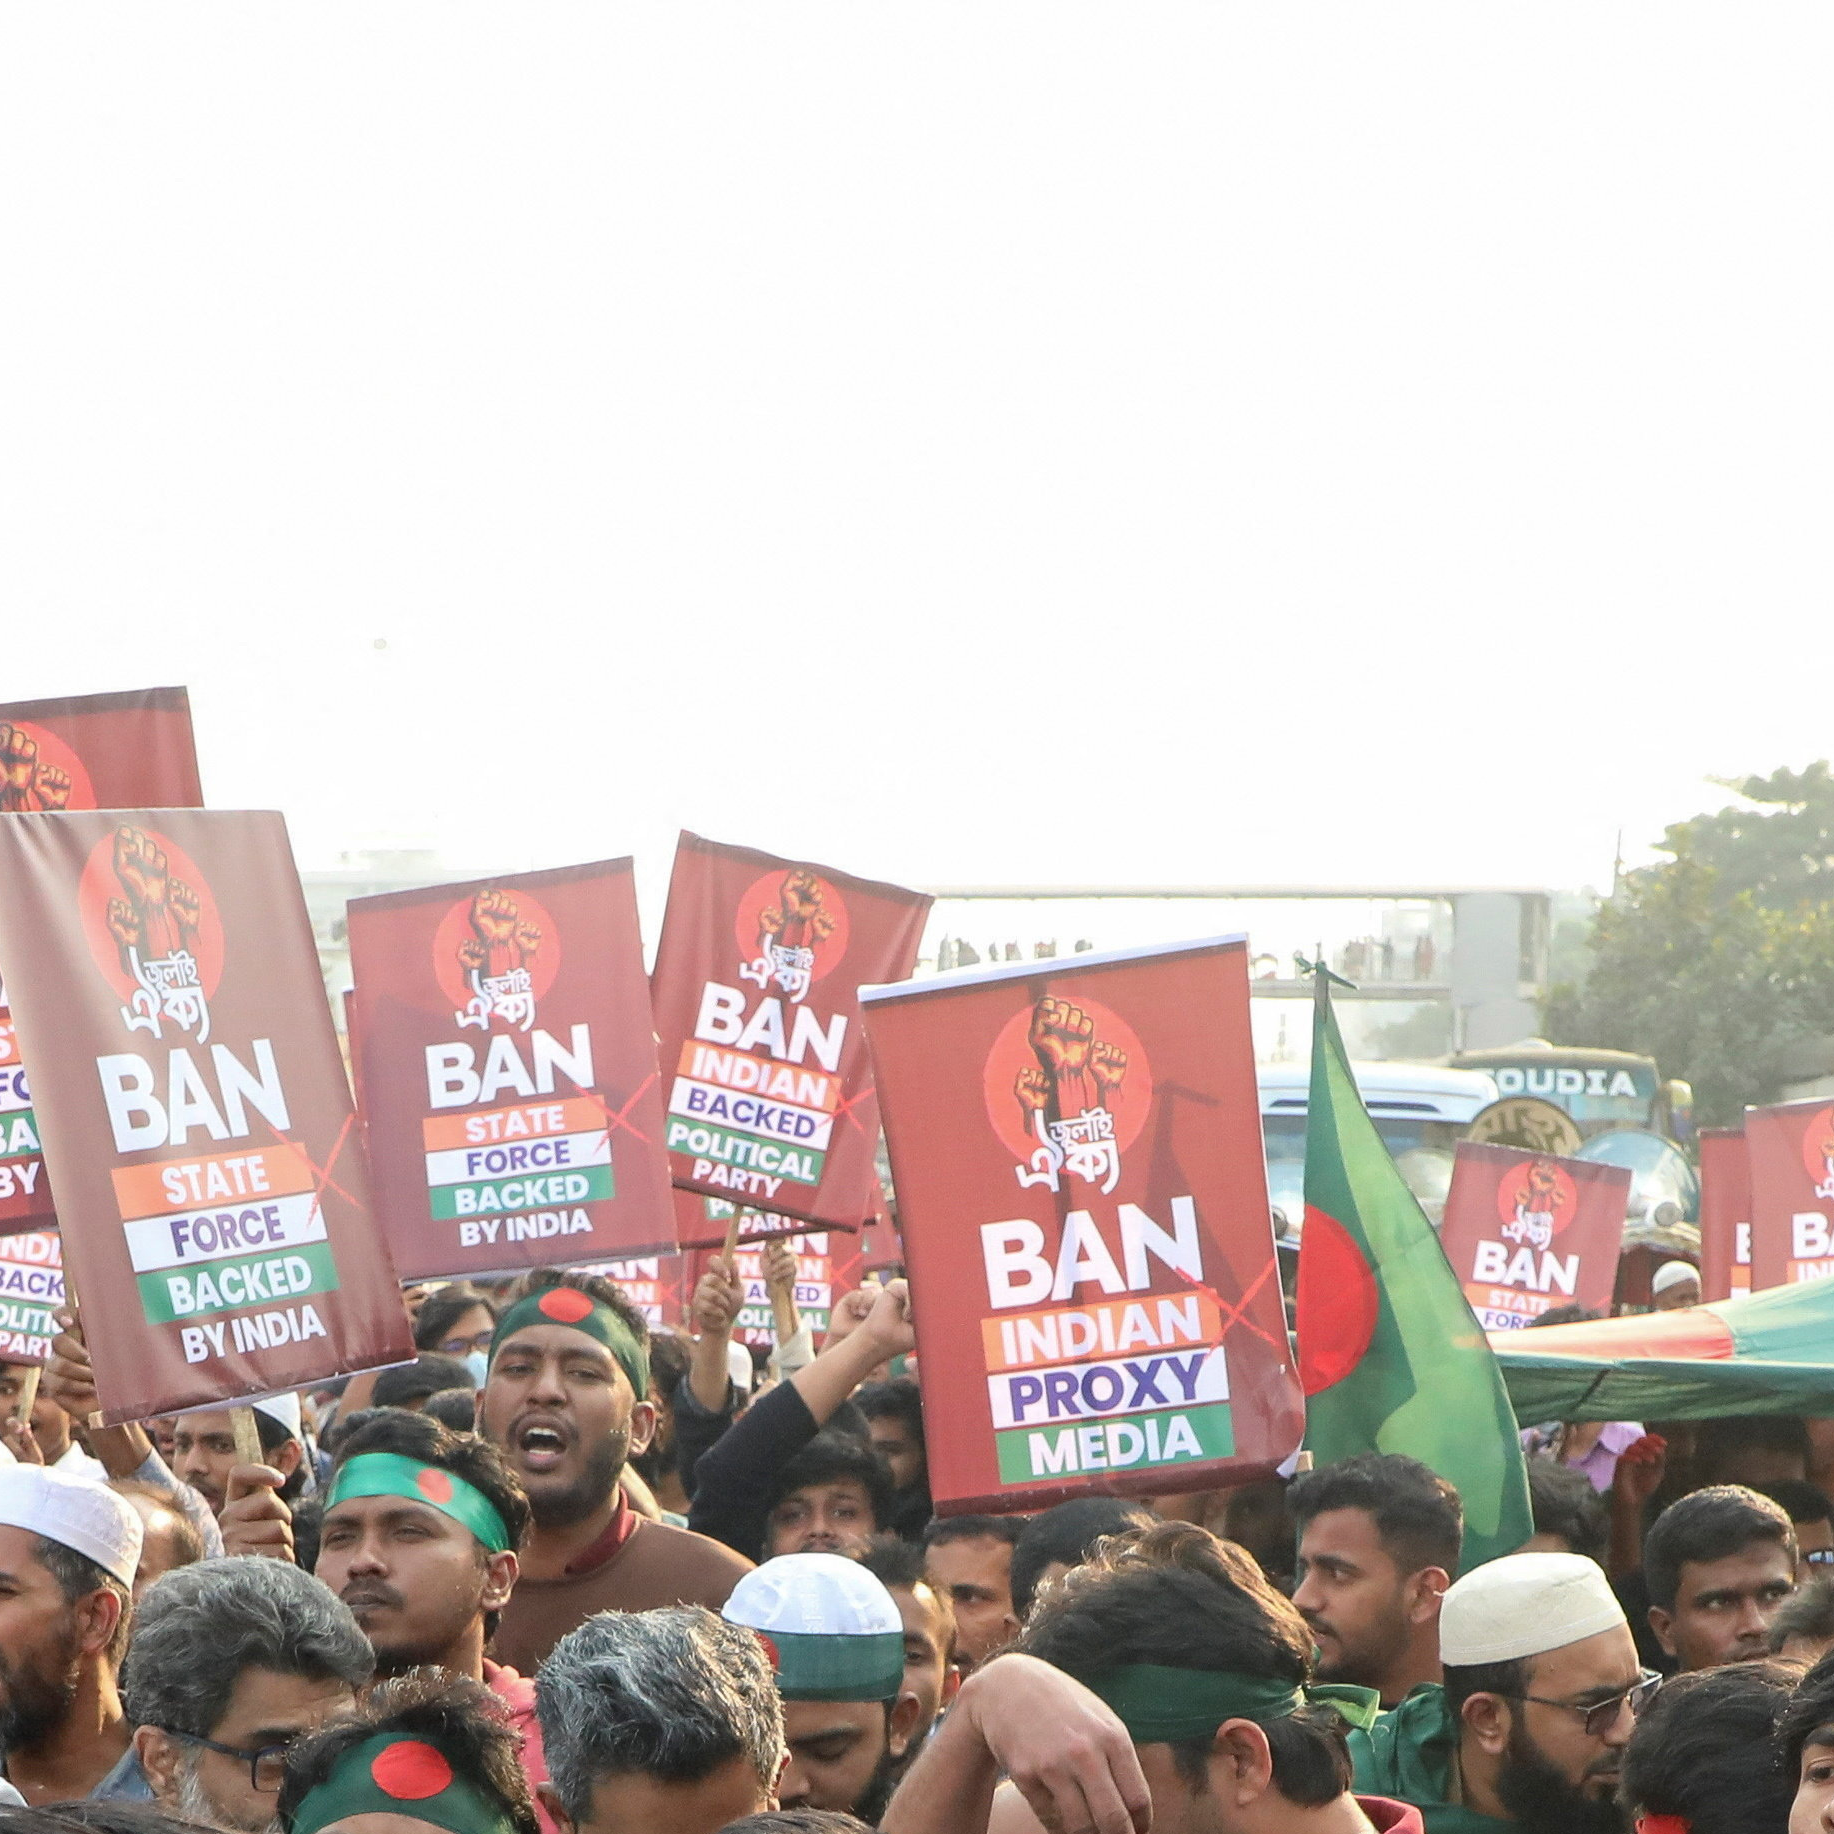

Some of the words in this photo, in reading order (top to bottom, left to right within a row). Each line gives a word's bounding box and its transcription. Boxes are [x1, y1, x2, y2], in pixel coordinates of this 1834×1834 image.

[120, 946, 211, 1045] ঐক্য
[143, 950, 201, 992] জুলাই
[455, 968, 536, 1033] ঐক্য
[694, 980, 849, 1073] BAN
[96, 1038, 292, 1153] BAN
[425, 1022, 595, 1110] BAN
[691, 1046, 829, 1107] INDIAN
[465, 1104, 566, 1142] STATE
[686, 1086, 816, 1139] BACKED
[1049, 1106, 1115, 1148] জুলাই
[161, 1155, 270, 1206] STATE
[467, 1139, 571, 1177] FORCE
[668, 1121, 816, 1182] POLITICAL
[692, 1158, 783, 1199] PARTY
[1014, 1108, 1121, 1196] ঐক্য
[454, 1173, 590, 1216] BACKED
[738, 1214, 805, 1235] PAR
[170, 1205, 285, 1258] FORCE
[459, 1218, 501, 1247] BY
[505, 1208, 594, 1242] INDIA
[979, 1195, 1205, 1311] BAN
[167, 1255, 313, 1315] BACKED
[1471, 1240, 1580, 1296] BAN
[181, 1321, 227, 1364] BY
[230, 1304, 327, 1355] INDIA
[999, 1296, 1203, 1366] INDIAN
[1008, 1352, 1208, 1423] PROXY
[1028, 1414, 1205, 1477] MEDIA
